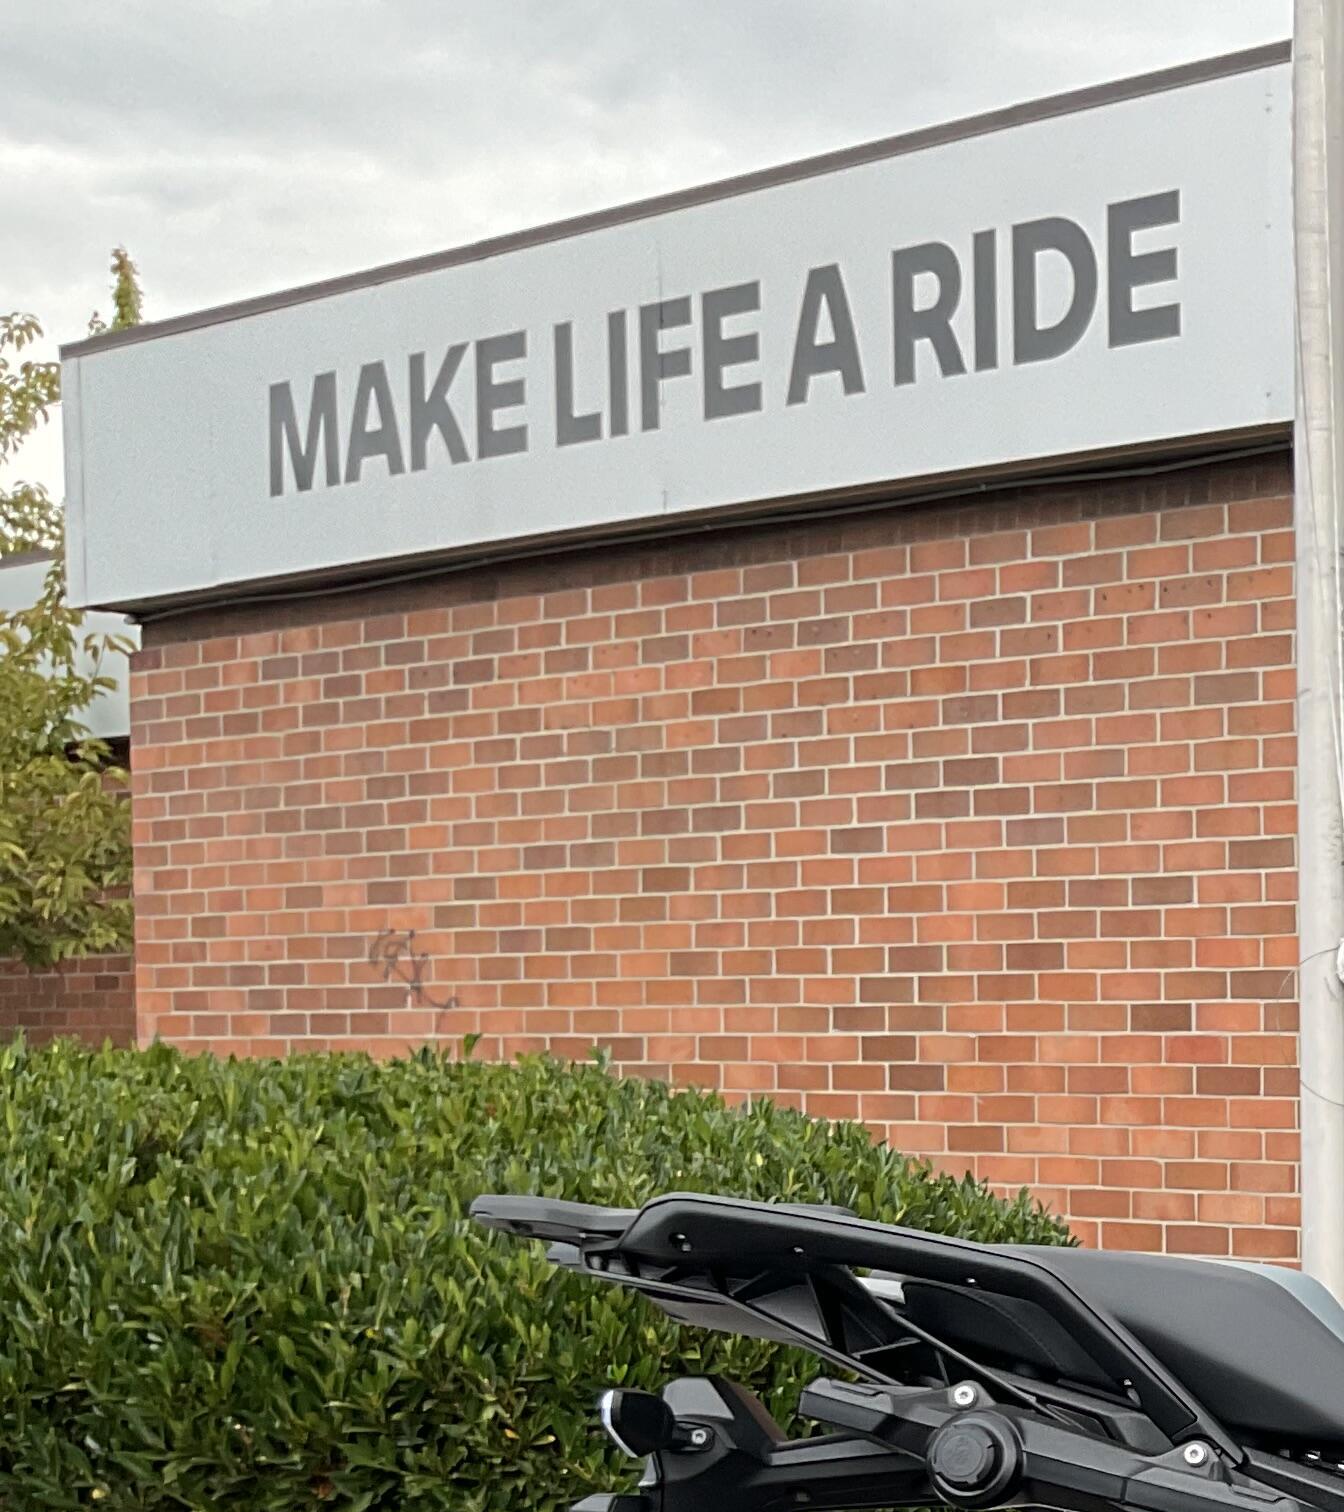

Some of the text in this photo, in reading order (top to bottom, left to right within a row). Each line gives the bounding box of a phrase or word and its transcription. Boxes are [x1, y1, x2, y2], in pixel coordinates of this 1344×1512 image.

[268, 187, 1181, 498] MAKE LIFE A RIDE
